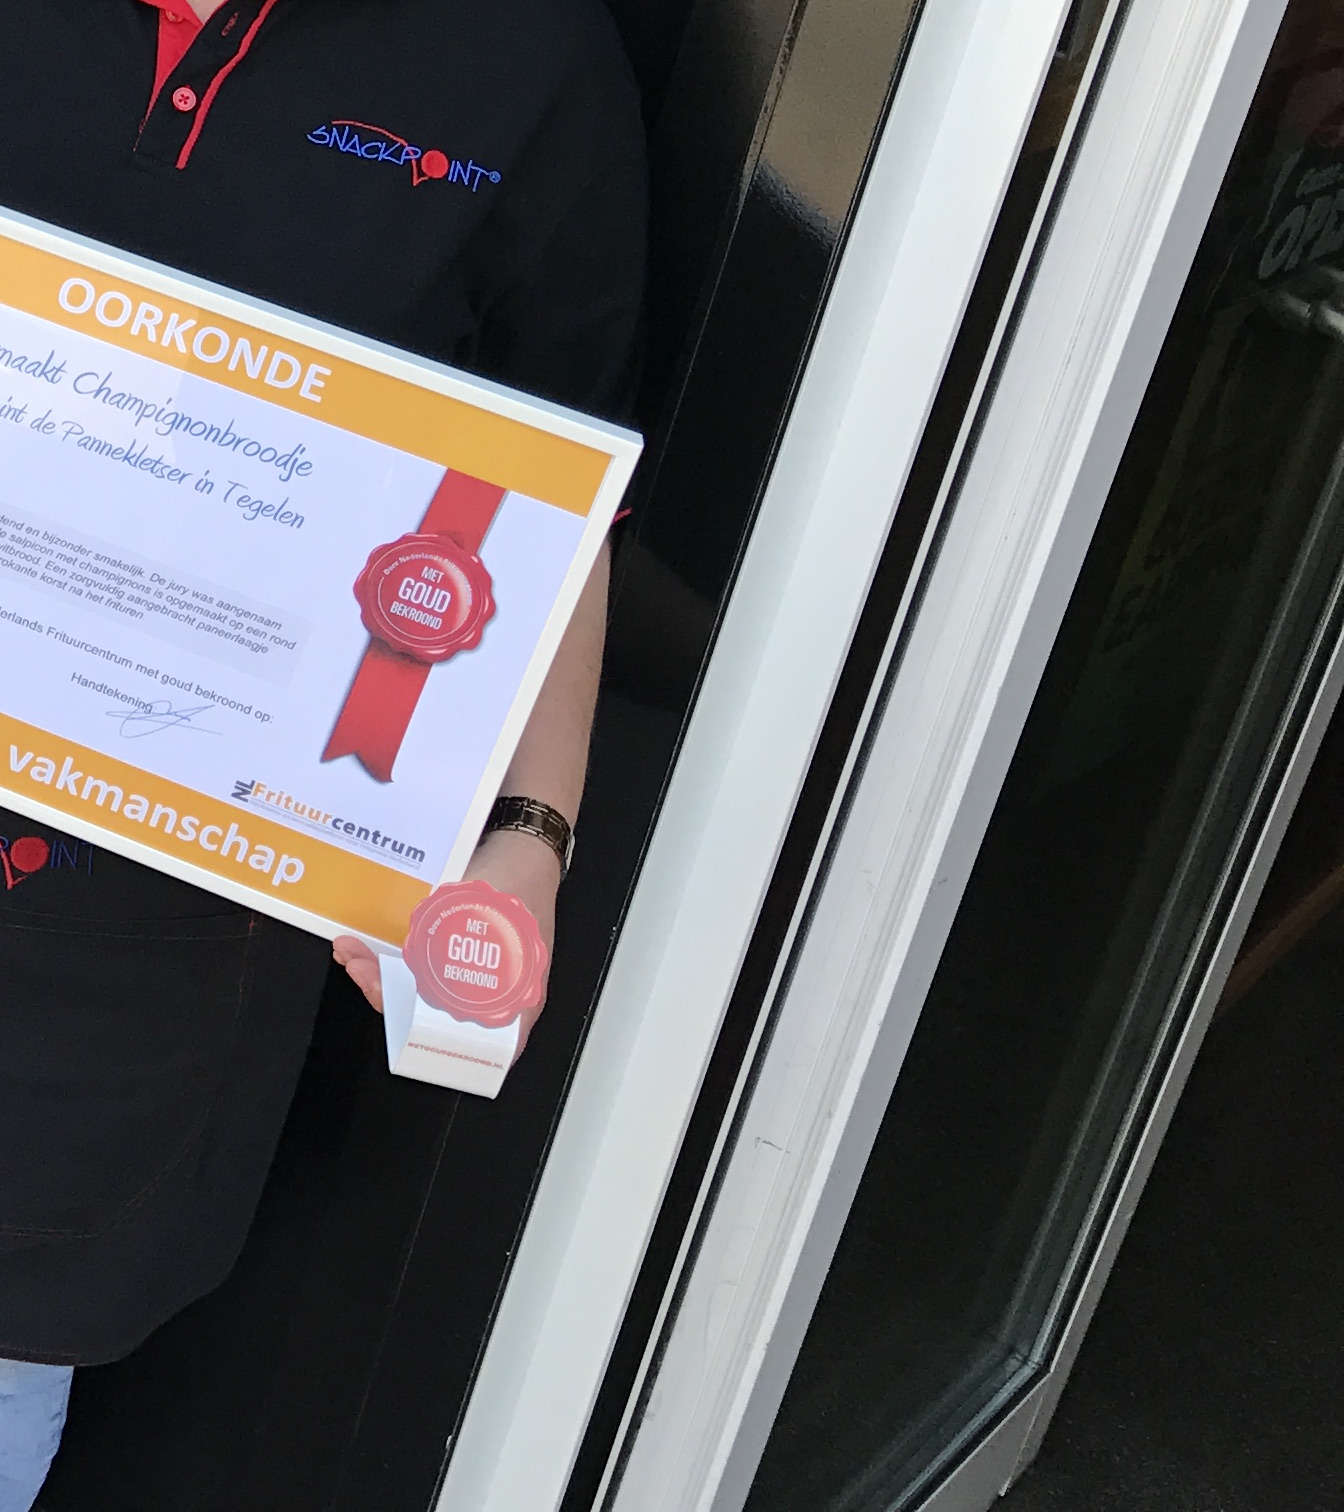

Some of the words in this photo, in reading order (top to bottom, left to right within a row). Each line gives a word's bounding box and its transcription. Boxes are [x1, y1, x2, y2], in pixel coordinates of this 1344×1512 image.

[57, 276, 331, 403] OORKONDE
[72, 371, 313, 482] Champignonbroodje
[28, 408, 56, 435] de
[61, 420, 193, 485] Pannekletser
[193, 468, 214, 495] in
[222, 479, 305, 529] Tegelen
[398, 576, 451, 614] GOUD
[421, 565, 445, 584] MET
[389, 600, 443, 630] BEKROOND
[45, 625, 133, 669] Frituurcentrum
[134, 663, 159, 679] met
[159, 673, 193, 692] goud
[193, 683, 253, 715] bekroond
[253, 709, 272, 723] op:
[9, 743, 305, 887] vakmanschap
[252, 780, 426, 863] Frituurcentrum
[447, 933, 501, 970] GOUD
[466, 918, 490, 936] MET
[443, 964, 499, 990] BEKROOND
